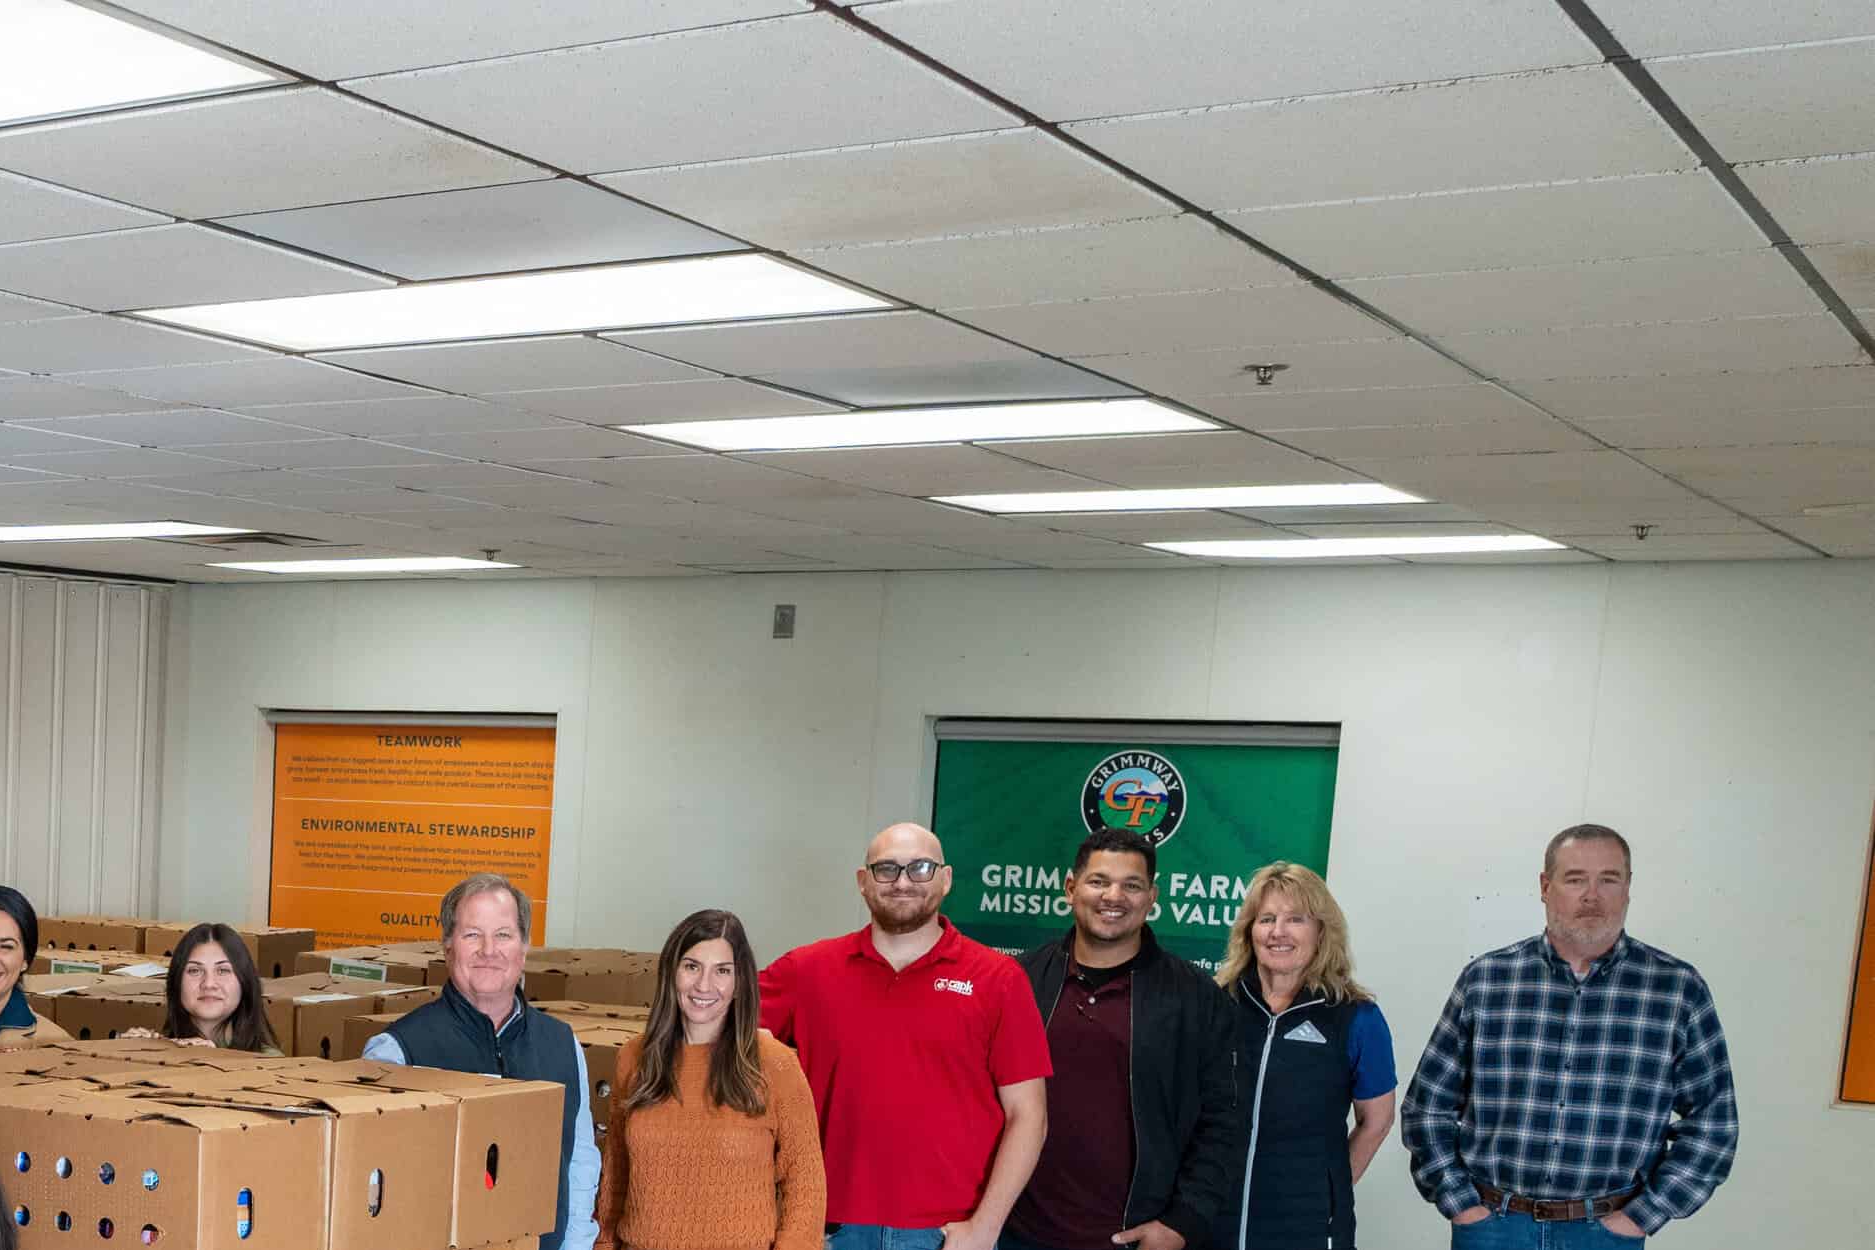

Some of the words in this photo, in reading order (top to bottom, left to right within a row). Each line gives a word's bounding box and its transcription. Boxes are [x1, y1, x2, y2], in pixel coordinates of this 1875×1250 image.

[376, 735, 462, 748] TEAMWORK
[1092, 755, 1180, 791] GRIMMWAY
[1105, 779, 1161, 827] GF
[301, 818, 424, 835] ENVIRONMENTAL
[428, 823, 536, 840] STEWARDSHIP
[1170, 873, 1250, 900] FARM
[380, 912, 442, 928] QUALITY
[980, 893, 1073, 916] MISSIO
[1171, 903, 1241, 926] VALU
